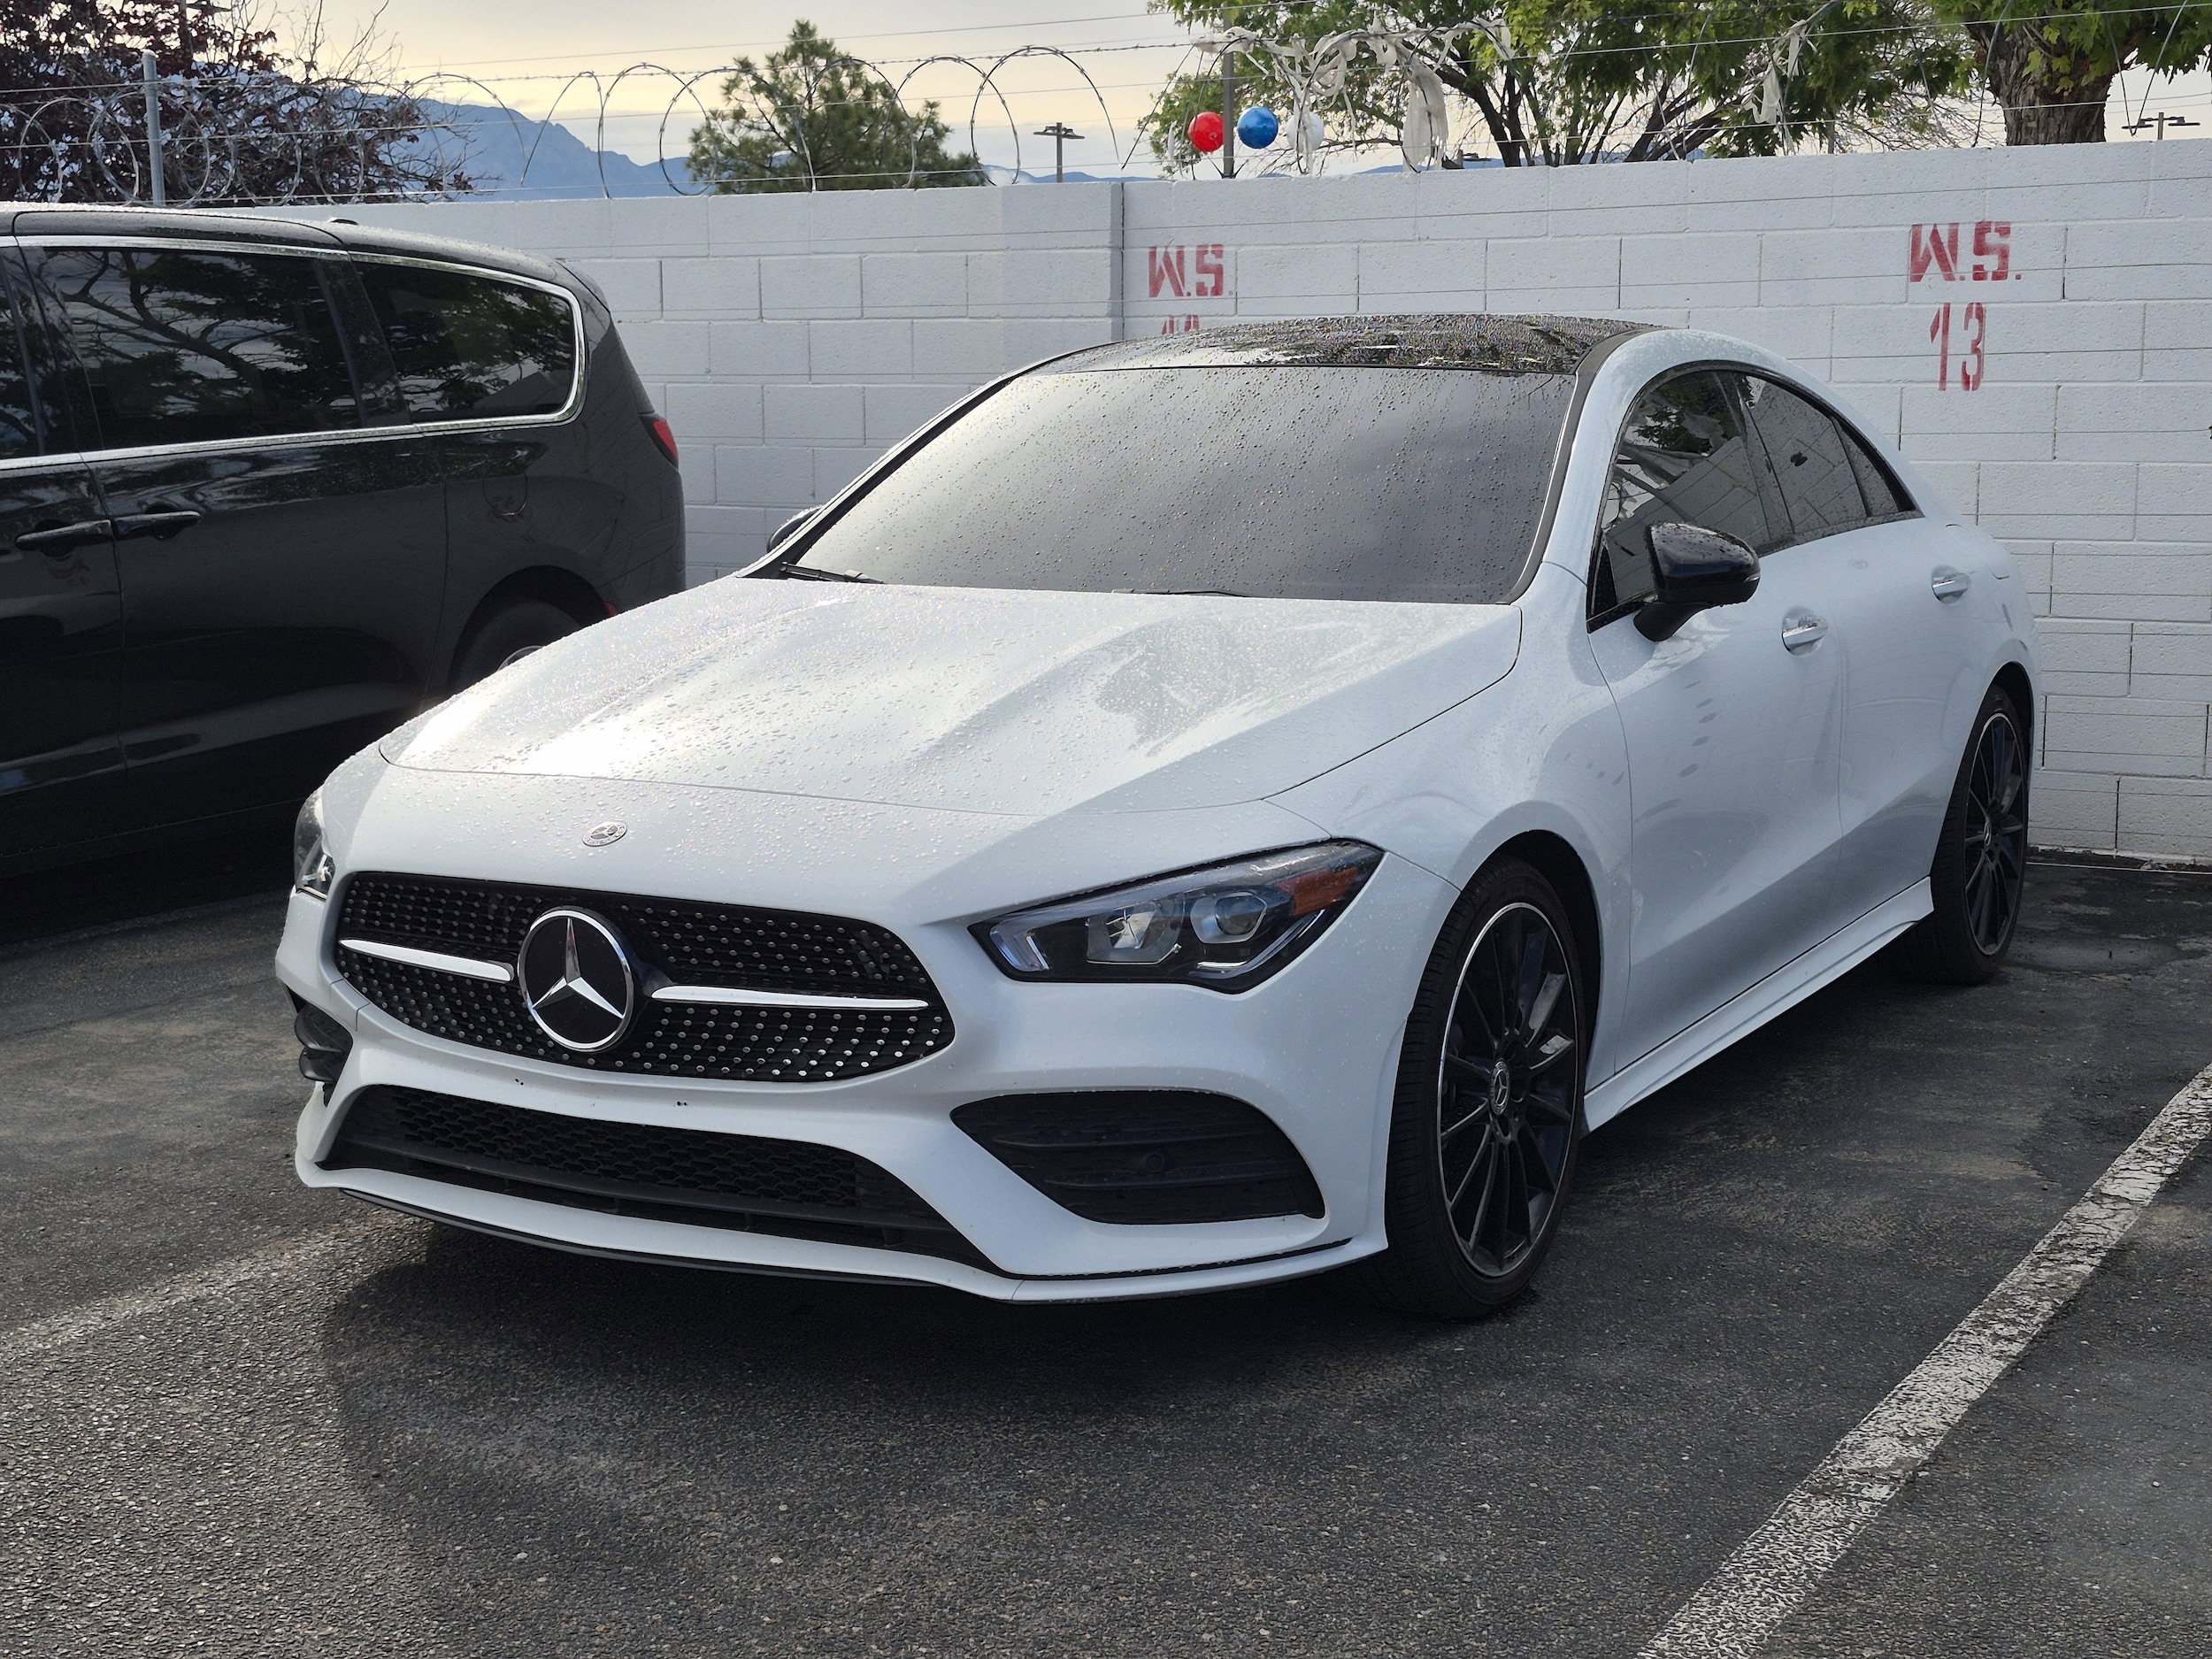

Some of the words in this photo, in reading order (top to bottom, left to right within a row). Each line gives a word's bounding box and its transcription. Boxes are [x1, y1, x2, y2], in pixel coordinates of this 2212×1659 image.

[1148, 243, 1233, 297] W.S.
[1909, 220, 2022, 282] W.S.
[1930, 302, 1985, 391] 13
